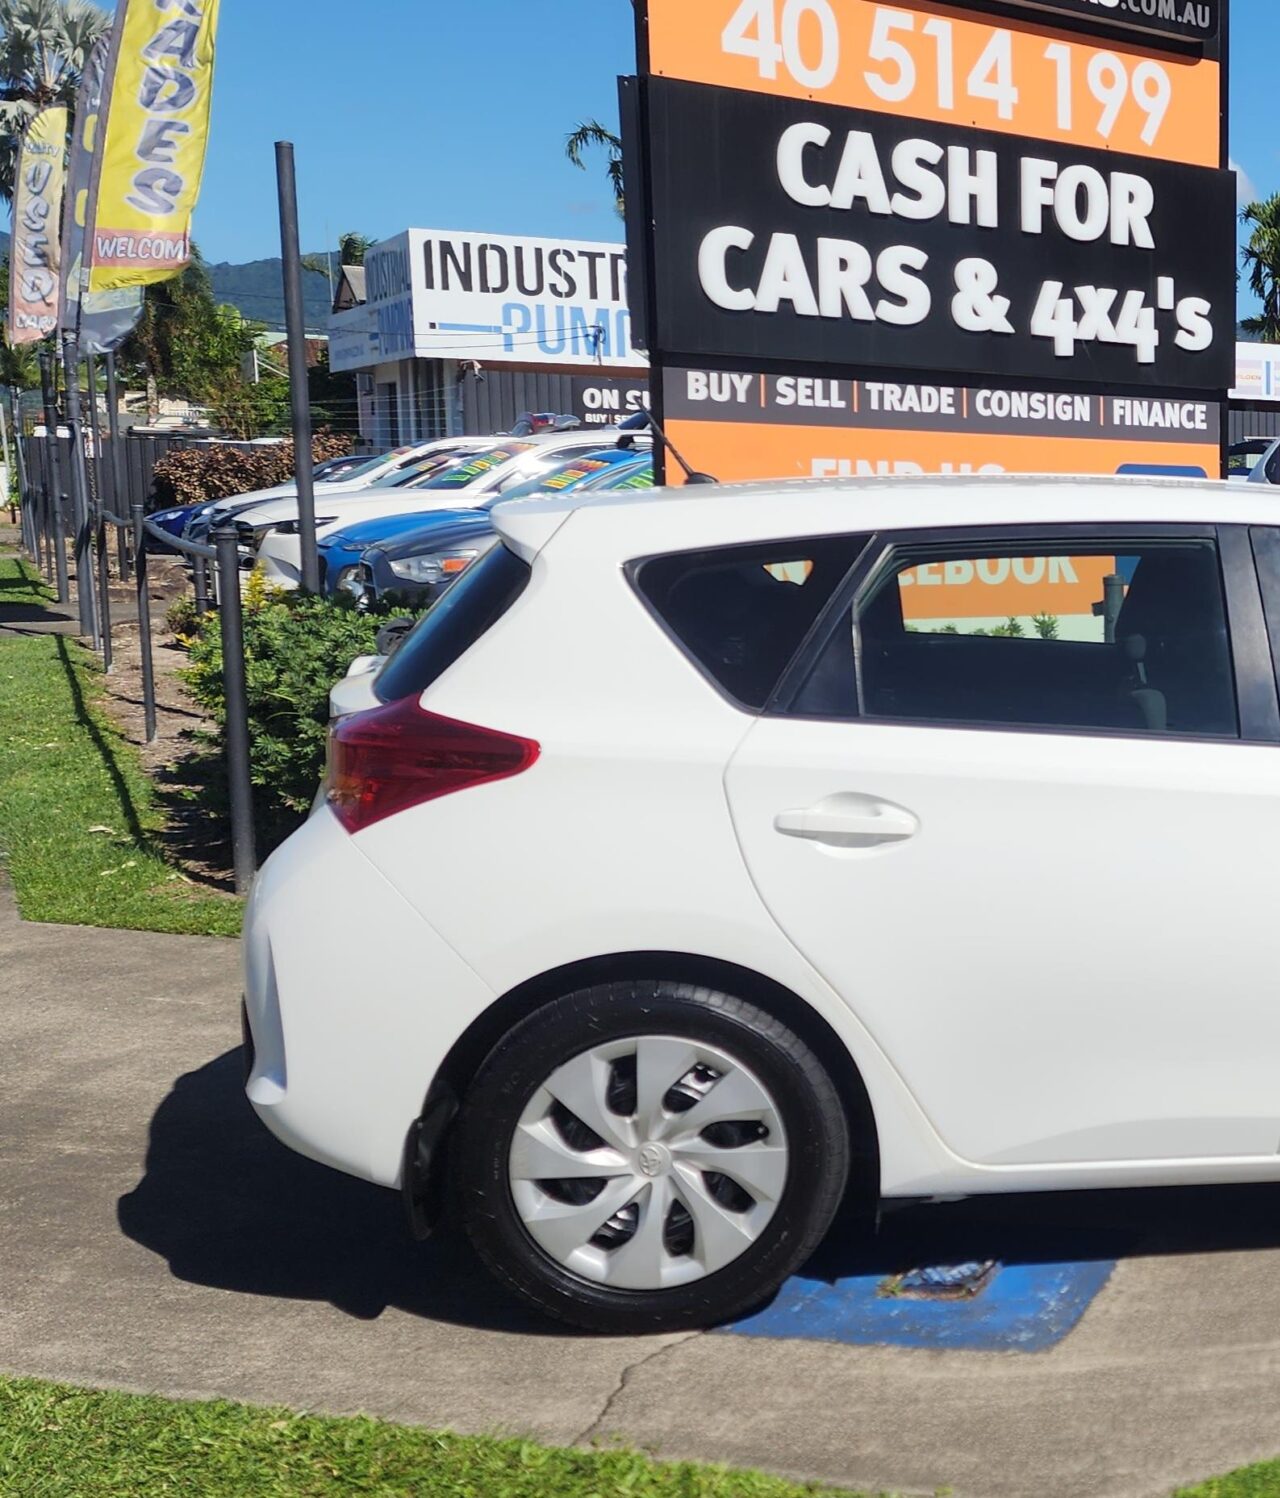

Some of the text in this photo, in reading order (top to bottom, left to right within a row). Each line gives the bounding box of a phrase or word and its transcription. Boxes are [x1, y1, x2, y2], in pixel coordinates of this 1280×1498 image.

[721, 0, 1172, 147] 40 514 199
[776, 121, 1156, 250] CASH FOR
[97, 236, 189, 261] WELCOM
[697, 225, 932, 326] CARS
[951, 257, 1015, 335] &
[582, 387, 620, 410] ON
[585, 413, 607, 424] BUY
[687, 372, 1208, 431] BUY SELL TRADE CONSIGN FINANCE
